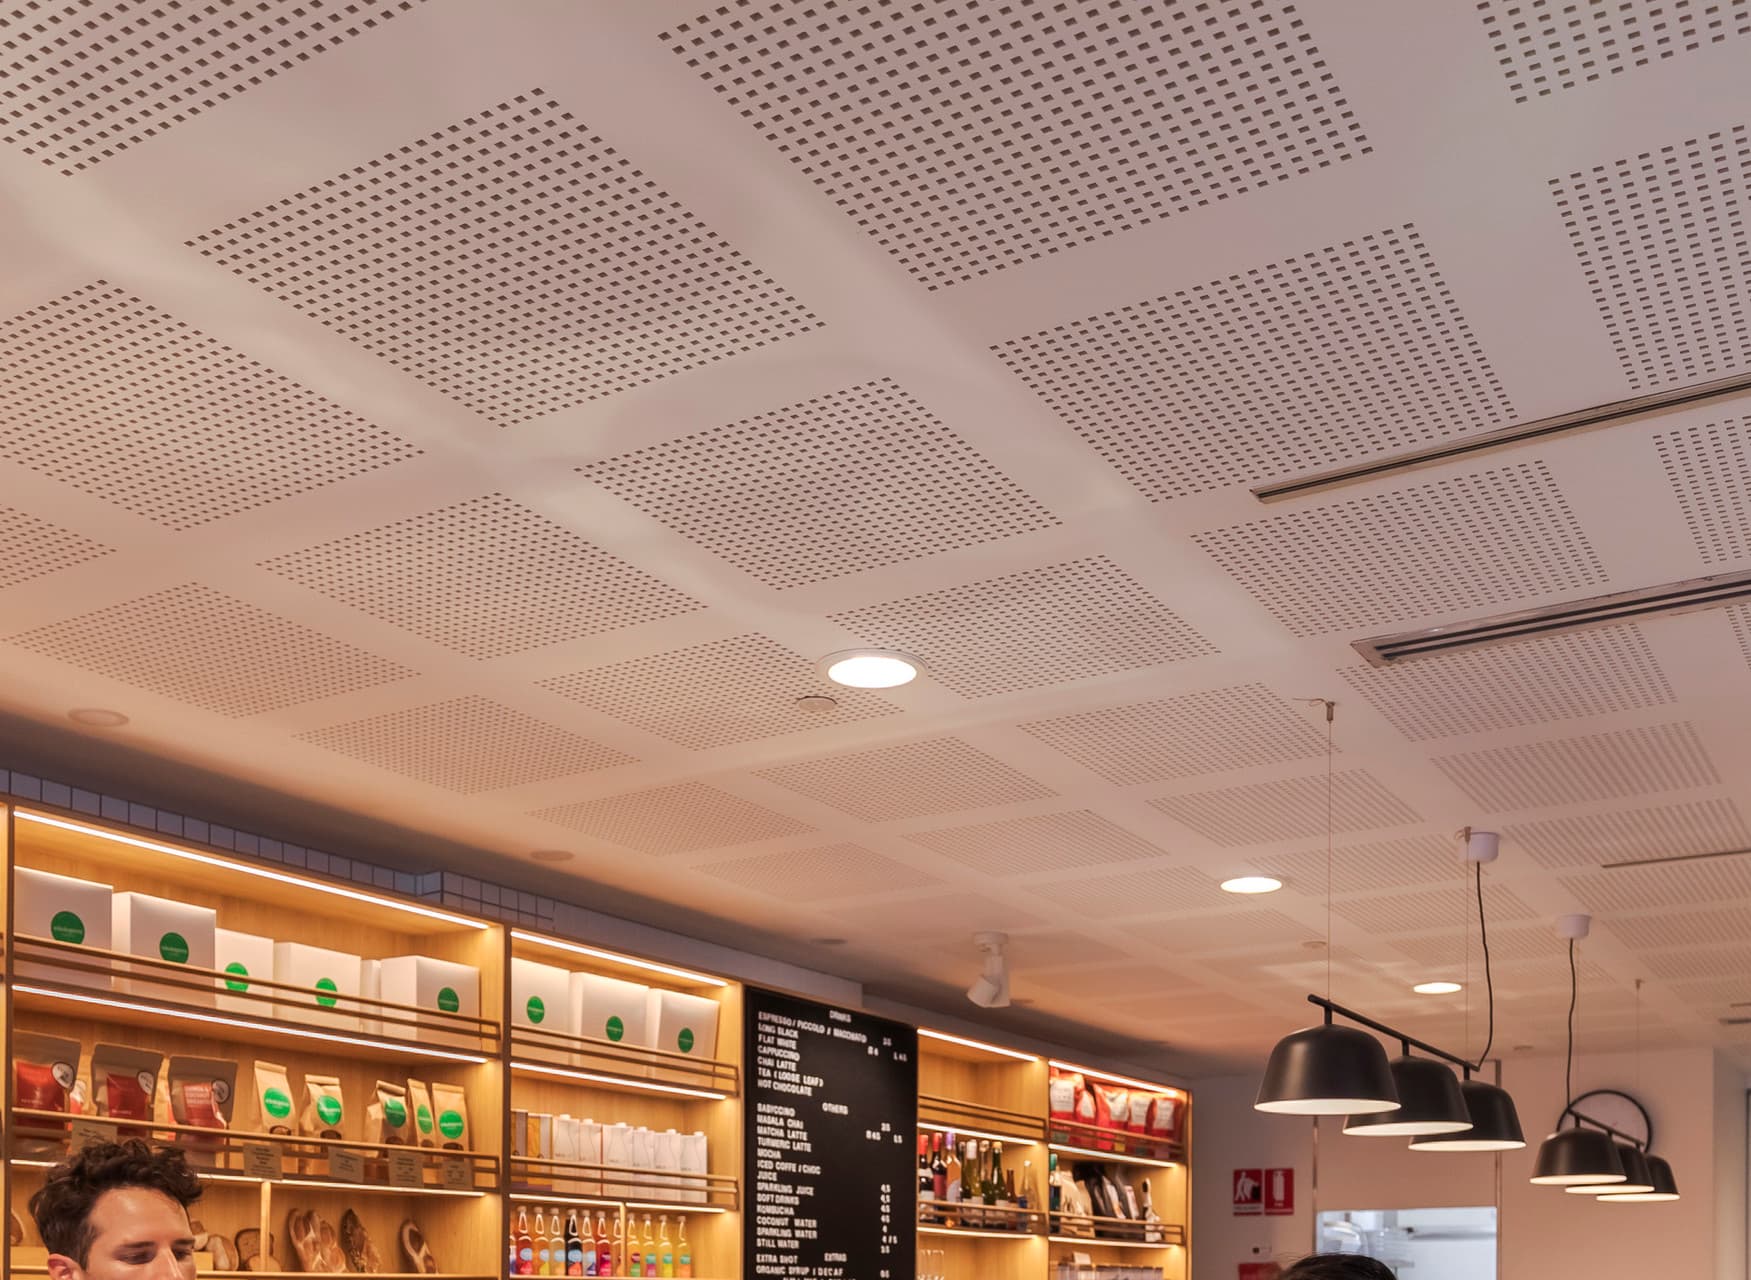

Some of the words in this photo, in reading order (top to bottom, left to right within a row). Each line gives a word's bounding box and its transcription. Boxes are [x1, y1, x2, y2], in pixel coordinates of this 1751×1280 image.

[758, 1011, 791, 1027] ESPRESSO
[797, 1020, 825, 1035] PICCOLO
[777, 1026, 799, 1039] BLACK
[758, 1034, 775, 1044] FLAT
[777, 1038, 797, 1049] WHITE
[757, 1056, 774, 1067] CHAI
[776, 1060, 796, 1071] LATTE
[758, 1067, 771, 1077] TEA
[757, 1079, 771, 1089] HOT
[773, 1081, 812, 1097] CHOCOLATE
[787, 1118, 803, 1129] CHAI
[757, 1126, 784, 1137] MATCHA
[787, 1130, 807, 1141] LATTE
[792, 1142, 811, 1152] LATTE
[757, 1160, 773, 1170] ICED
[803, 1165, 821, 1175] CHOC
[757, 1171, 778, 1181] JUICE
[796, 1186, 814, 1196] JUICE
[757, 1193, 774, 1203] SOFT
[757, 1204, 795, 1215] KOMBUCHA
[756, 1216, 789, 1226] COCONUT
[794, 1218, 817, 1228] WATER
[795, 1229, 817, 1240] WATER
[756, 1238, 776, 1248] STILL
[777, 1239, 799, 1249] WATER
[756, 1254, 778, 1263] EXTRA
[780, 1255, 798, 1264] SHOT
[756, 1265, 786, 1275] ORGANIC
[788, 1267, 810, 1276] SYRUP
[818, 1267, 843, 1276] DECAF
